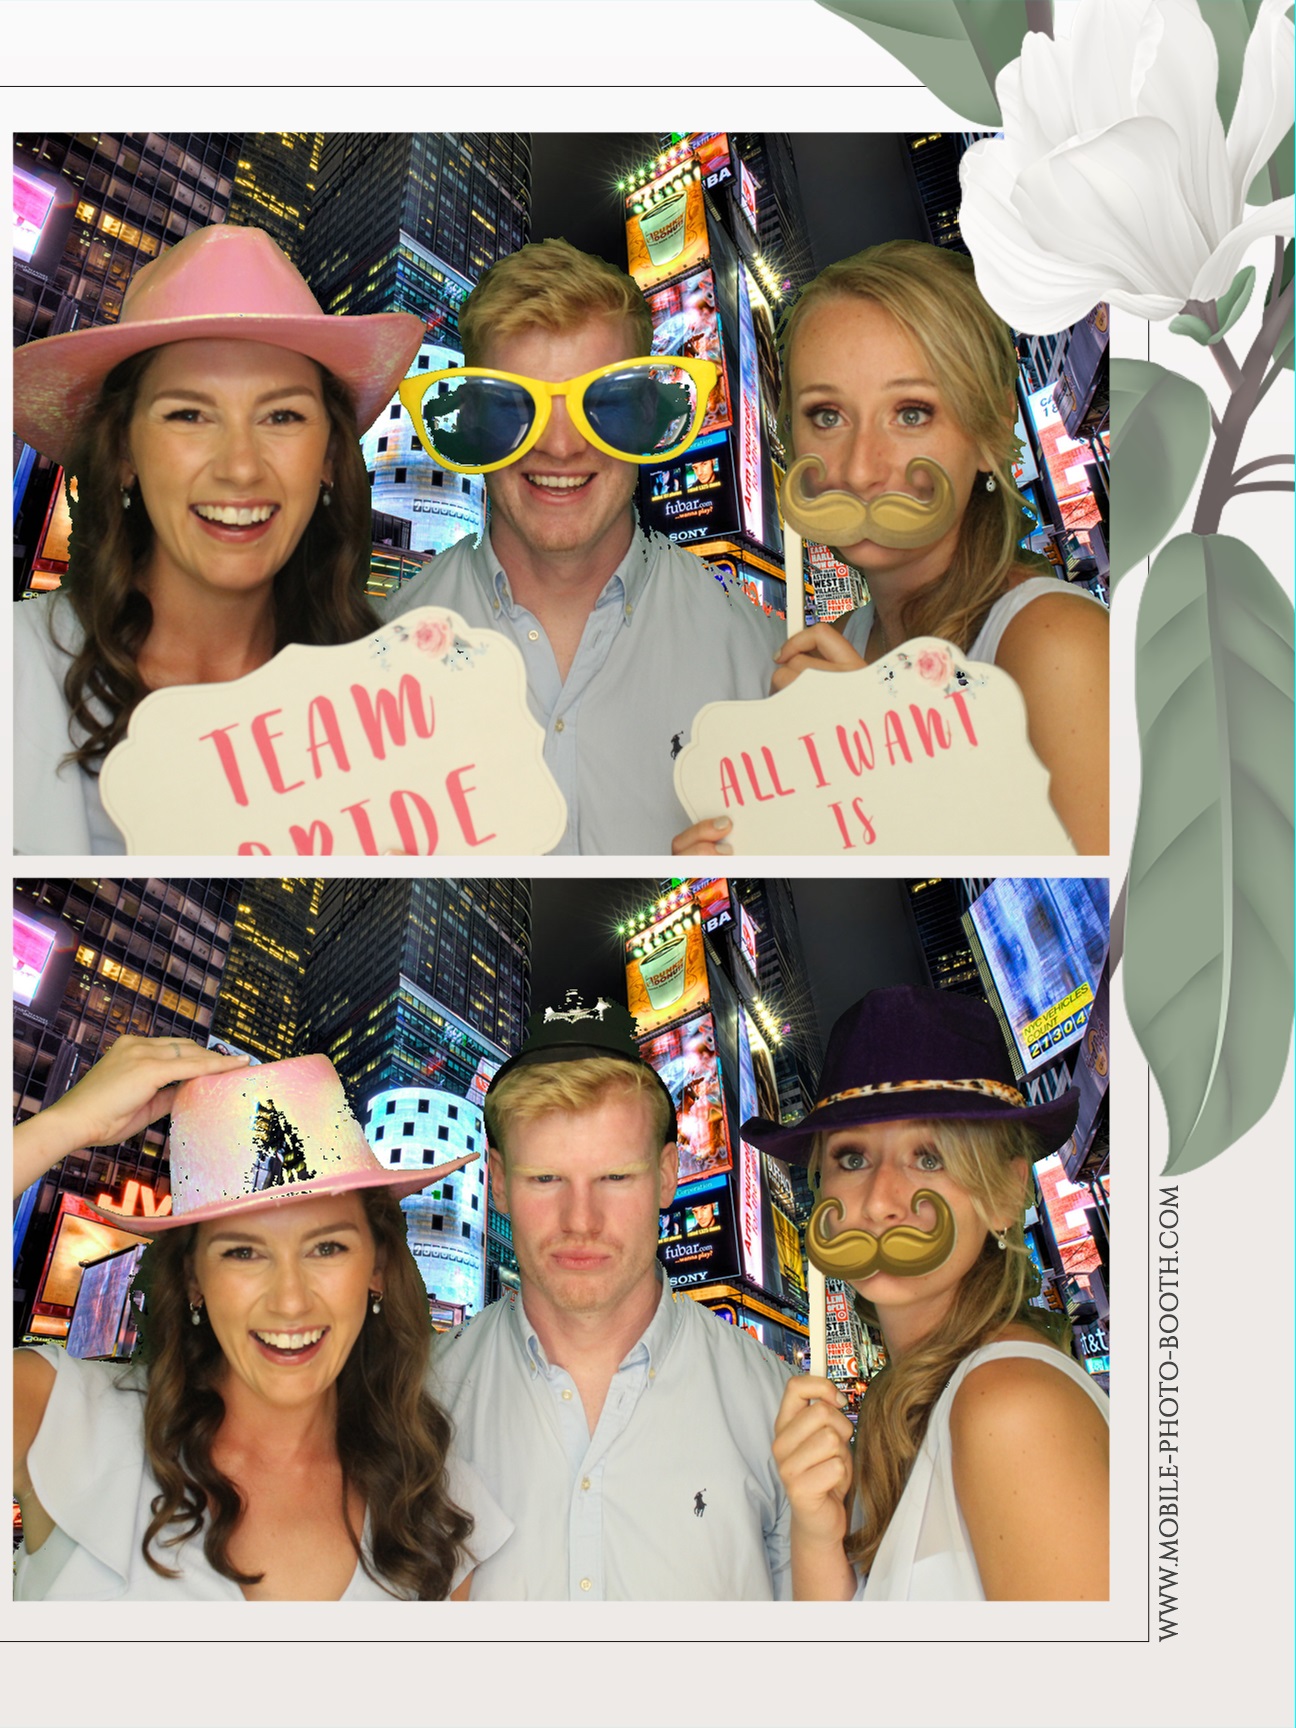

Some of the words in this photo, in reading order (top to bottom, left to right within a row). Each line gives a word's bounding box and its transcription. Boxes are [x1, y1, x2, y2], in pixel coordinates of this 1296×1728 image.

[669, 527, 708, 542] SONY
[198, 672, 436, 808] TEAM
[719, 735, 796, 809] ALL
[798, 732, 832, 790] I
[835, 688, 979, 779] WANT
[236, 764, 497, 856] RIDE
[827, 796, 878, 850] IS
[1024, 1017, 1043, 1036] NYC
[1043, 983, 1089, 1022] VEHICLES
[1027, 1016, 1058, 1044] COUNT
[96, 1179, 173, 1217] JV
[669, 1271, 708, 1286] SONY
[1080, 1328, 1109, 1355] t&t
